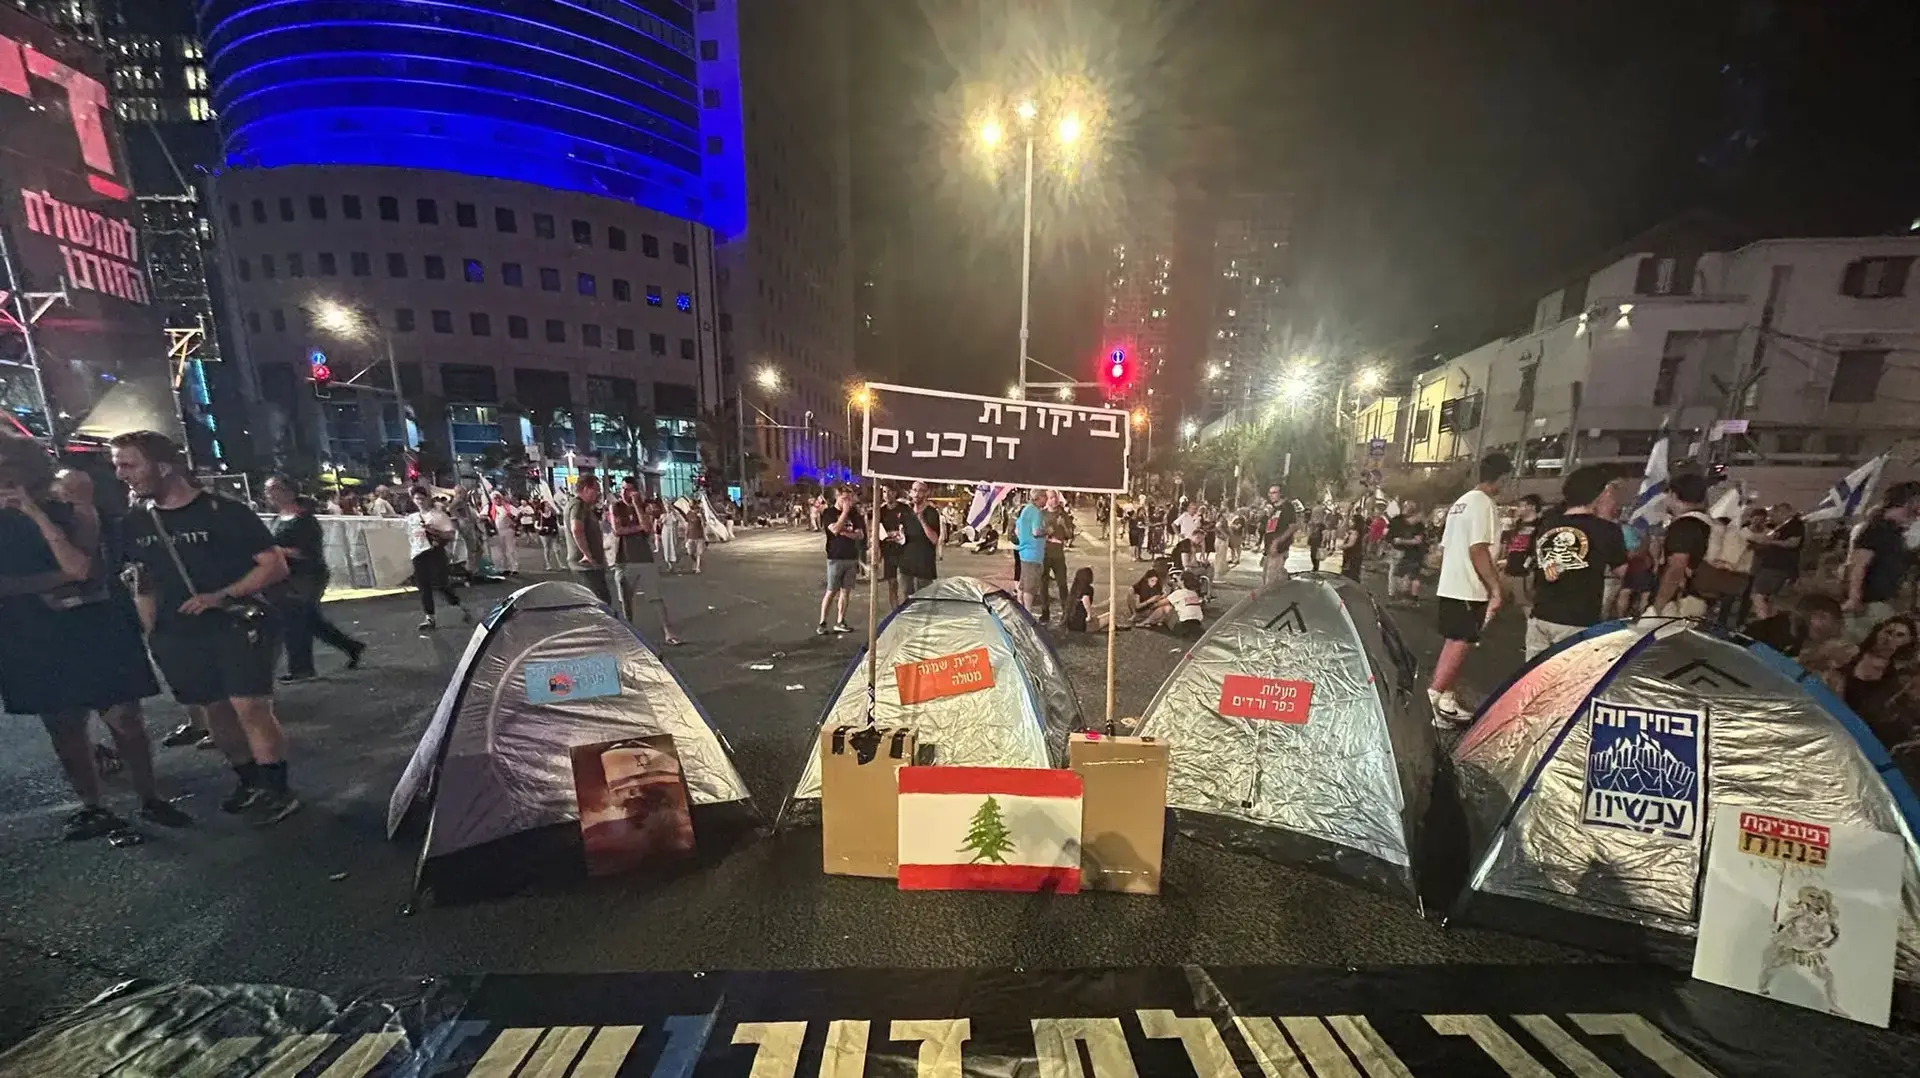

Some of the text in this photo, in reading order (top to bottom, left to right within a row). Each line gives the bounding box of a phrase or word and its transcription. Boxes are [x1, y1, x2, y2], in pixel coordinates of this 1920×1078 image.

[58, 244, 150, 305] החורבן
[978, 402, 1120, 438] ביקורת
[869, 427, 1021, 460] דרכנים
[953, 653, 979, 668] קרית
[952, 671, 982, 685] מטולה
[1260, 683, 1297, 699] מעלות
[1232, 696, 1294, 712] כפר ורדים
[1594, 706, 1694, 738] בחירות
[1594, 792, 1687, 829] עכשיו!
[1742, 814, 1830, 844] רפובליקת
[1743, 832, 1827, 865] בננות
